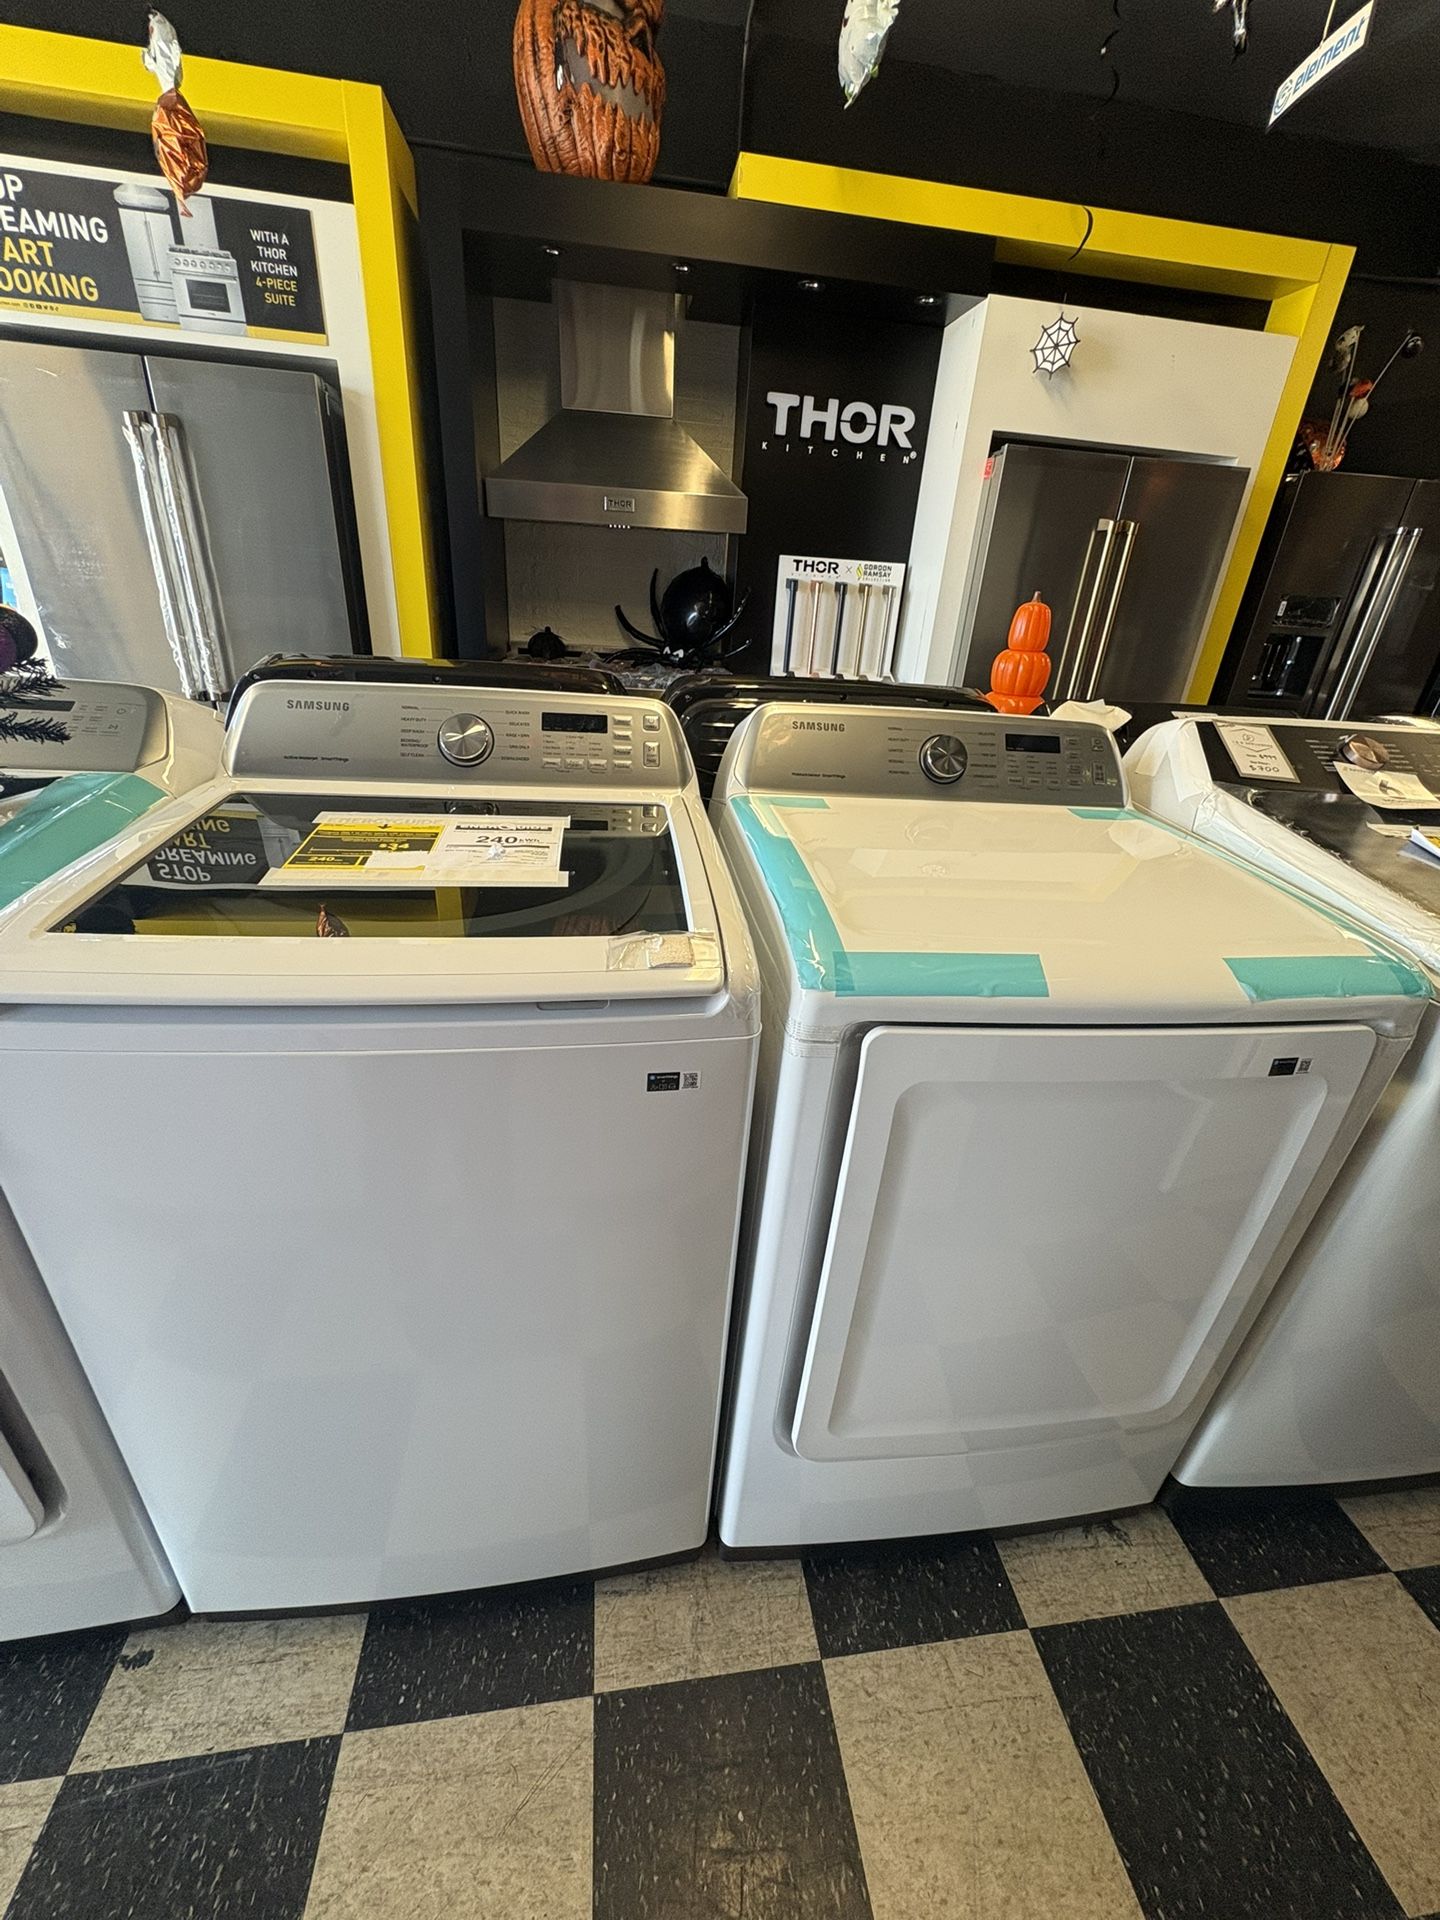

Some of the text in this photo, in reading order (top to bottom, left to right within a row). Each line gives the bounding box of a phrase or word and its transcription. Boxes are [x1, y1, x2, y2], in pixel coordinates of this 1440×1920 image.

[1292, 16, 1366, 95] element
[0, 205, 109, 244] EAMING
[249, 228, 290, 246] WITH A
[256, 245, 287, 261] THOR
[250, 260, 298, 277] KITCHEN
[256, 276, 298, 292] 4-PIECE
[265, 292, 296, 307] SUITE
[766, 391, 917, 448] THOR
[608, 499, 632, 508] THOR
[793, 559, 839, 574] THOR
[863, 563, 892, 571] GORDON
[863, 570, 892, 578] RAMSAY
[286, 699, 350, 711] SAMSUNG
[792, 720, 845, 732] SAMSUNG
[475, 835, 518, 844] 240
